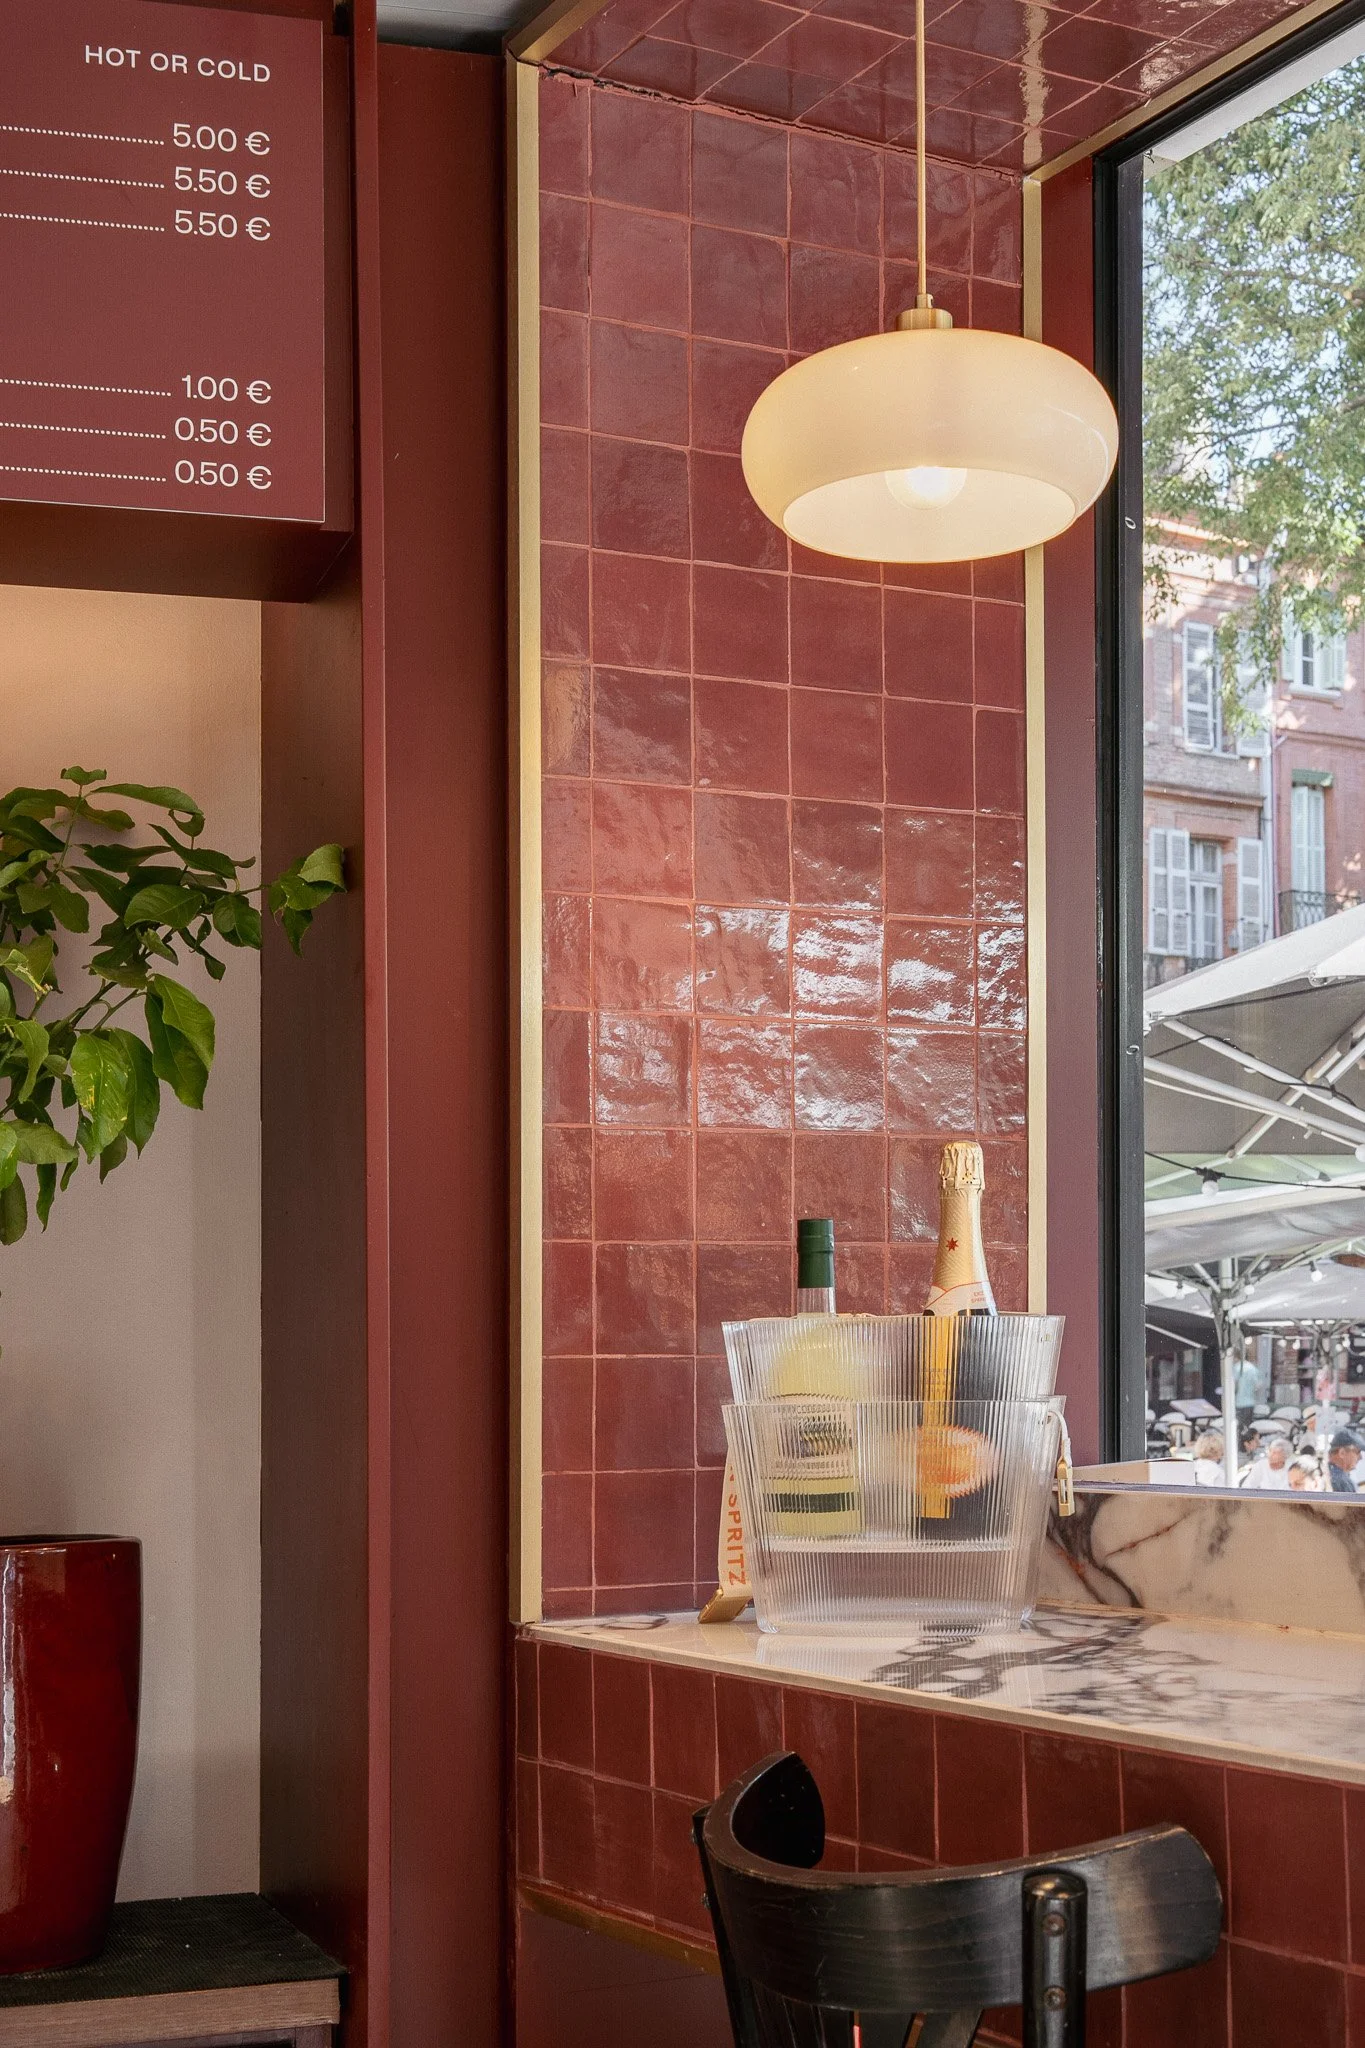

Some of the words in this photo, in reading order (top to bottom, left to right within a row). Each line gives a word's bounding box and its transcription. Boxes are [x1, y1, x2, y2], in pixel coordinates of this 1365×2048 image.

[85, 45, 140, 68] HOT
[150, 53, 188, 74] OR
[197, 58, 271, 82] COLD
[173, 123, 237, 152] 5.00
[245, 131, 270, 155] €
[174, 167, 237, 195] 5.50
[245, 174, 271, 198] €
[174, 210, 237, 238] 5.50
[245, 217, 271, 241] €
[181, 375, 239, 401] 1.00
[246, 381, 271, 404] €
[174, 417, 239, 444] 0.50
[246, 423, 271, 447] €
[174, 460, 239, 487] 0.50
[246, 466, 271, 490] €
[727, 1493, 747, 1586] SPRITZ
